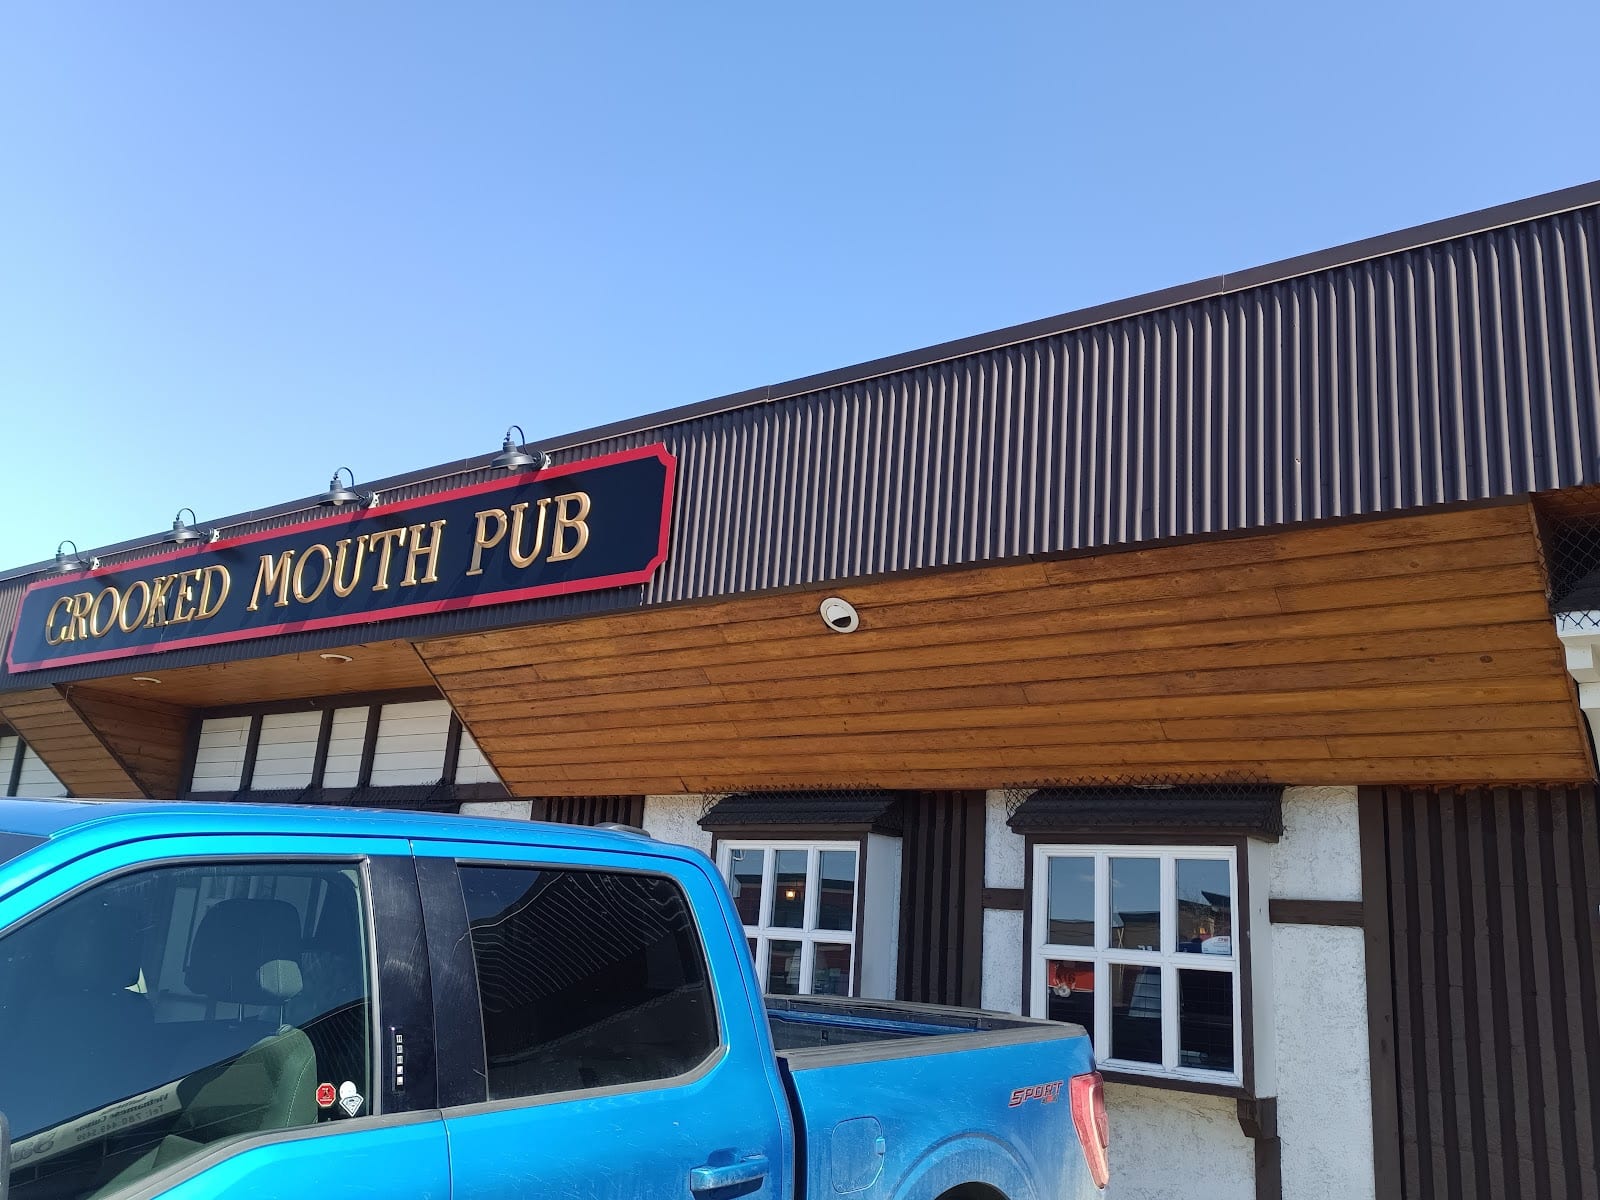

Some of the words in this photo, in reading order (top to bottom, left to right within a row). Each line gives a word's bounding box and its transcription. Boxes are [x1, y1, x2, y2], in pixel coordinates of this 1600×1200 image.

[45, 564, 231, 646] CROOKED
[246, 519, 447, 611] MOUTH
[466, 491, 591, 576] PUB
[1008, 1080, 1064, 1108] SPORT
